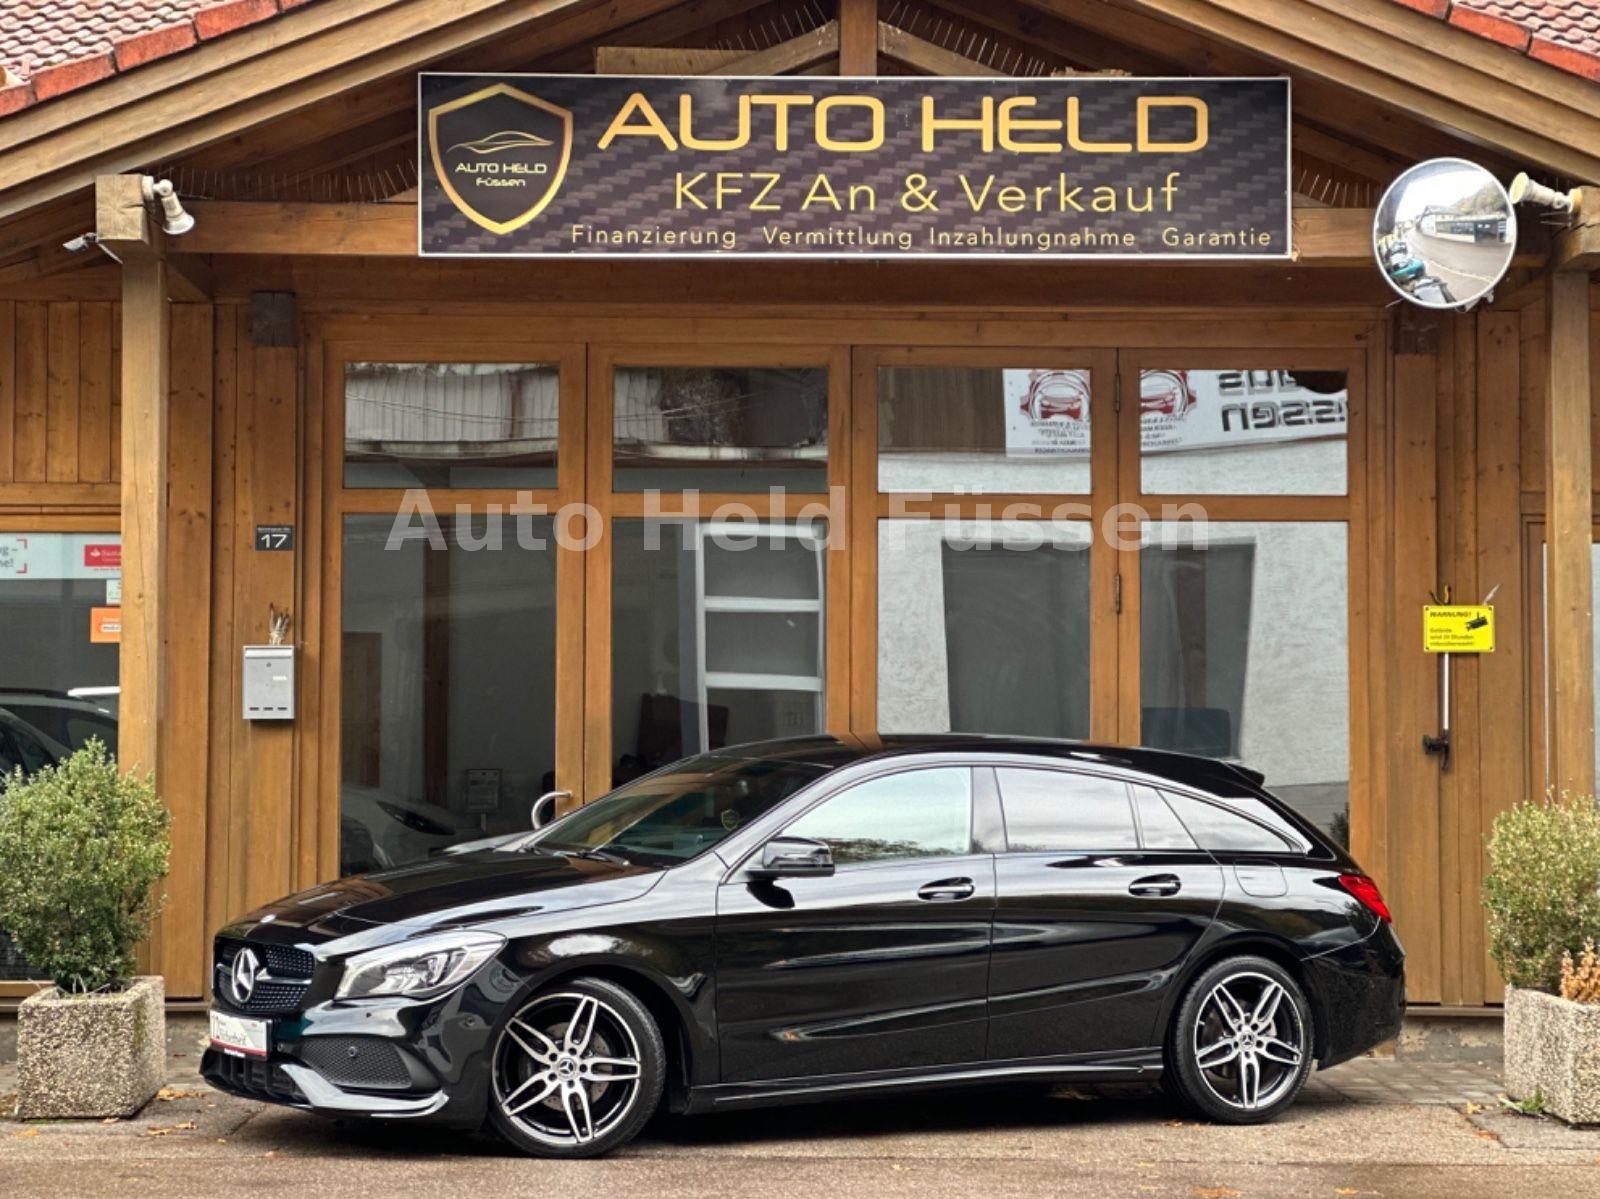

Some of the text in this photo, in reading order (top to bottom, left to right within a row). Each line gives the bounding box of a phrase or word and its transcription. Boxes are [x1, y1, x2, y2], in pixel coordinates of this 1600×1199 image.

[597, 92, 1209, 153] AUTO HELD
[455, 163, 547, 174] AUTO HELD
[475, 176, 526, 187] Füssen
[675, 172, 1181, 213] KFZ An & Verkauf
[571, 224, 1272, 251] Finanzierung Vermittlung Inzahlungnahme Garantie
[260, 533, 288, 549] 17
